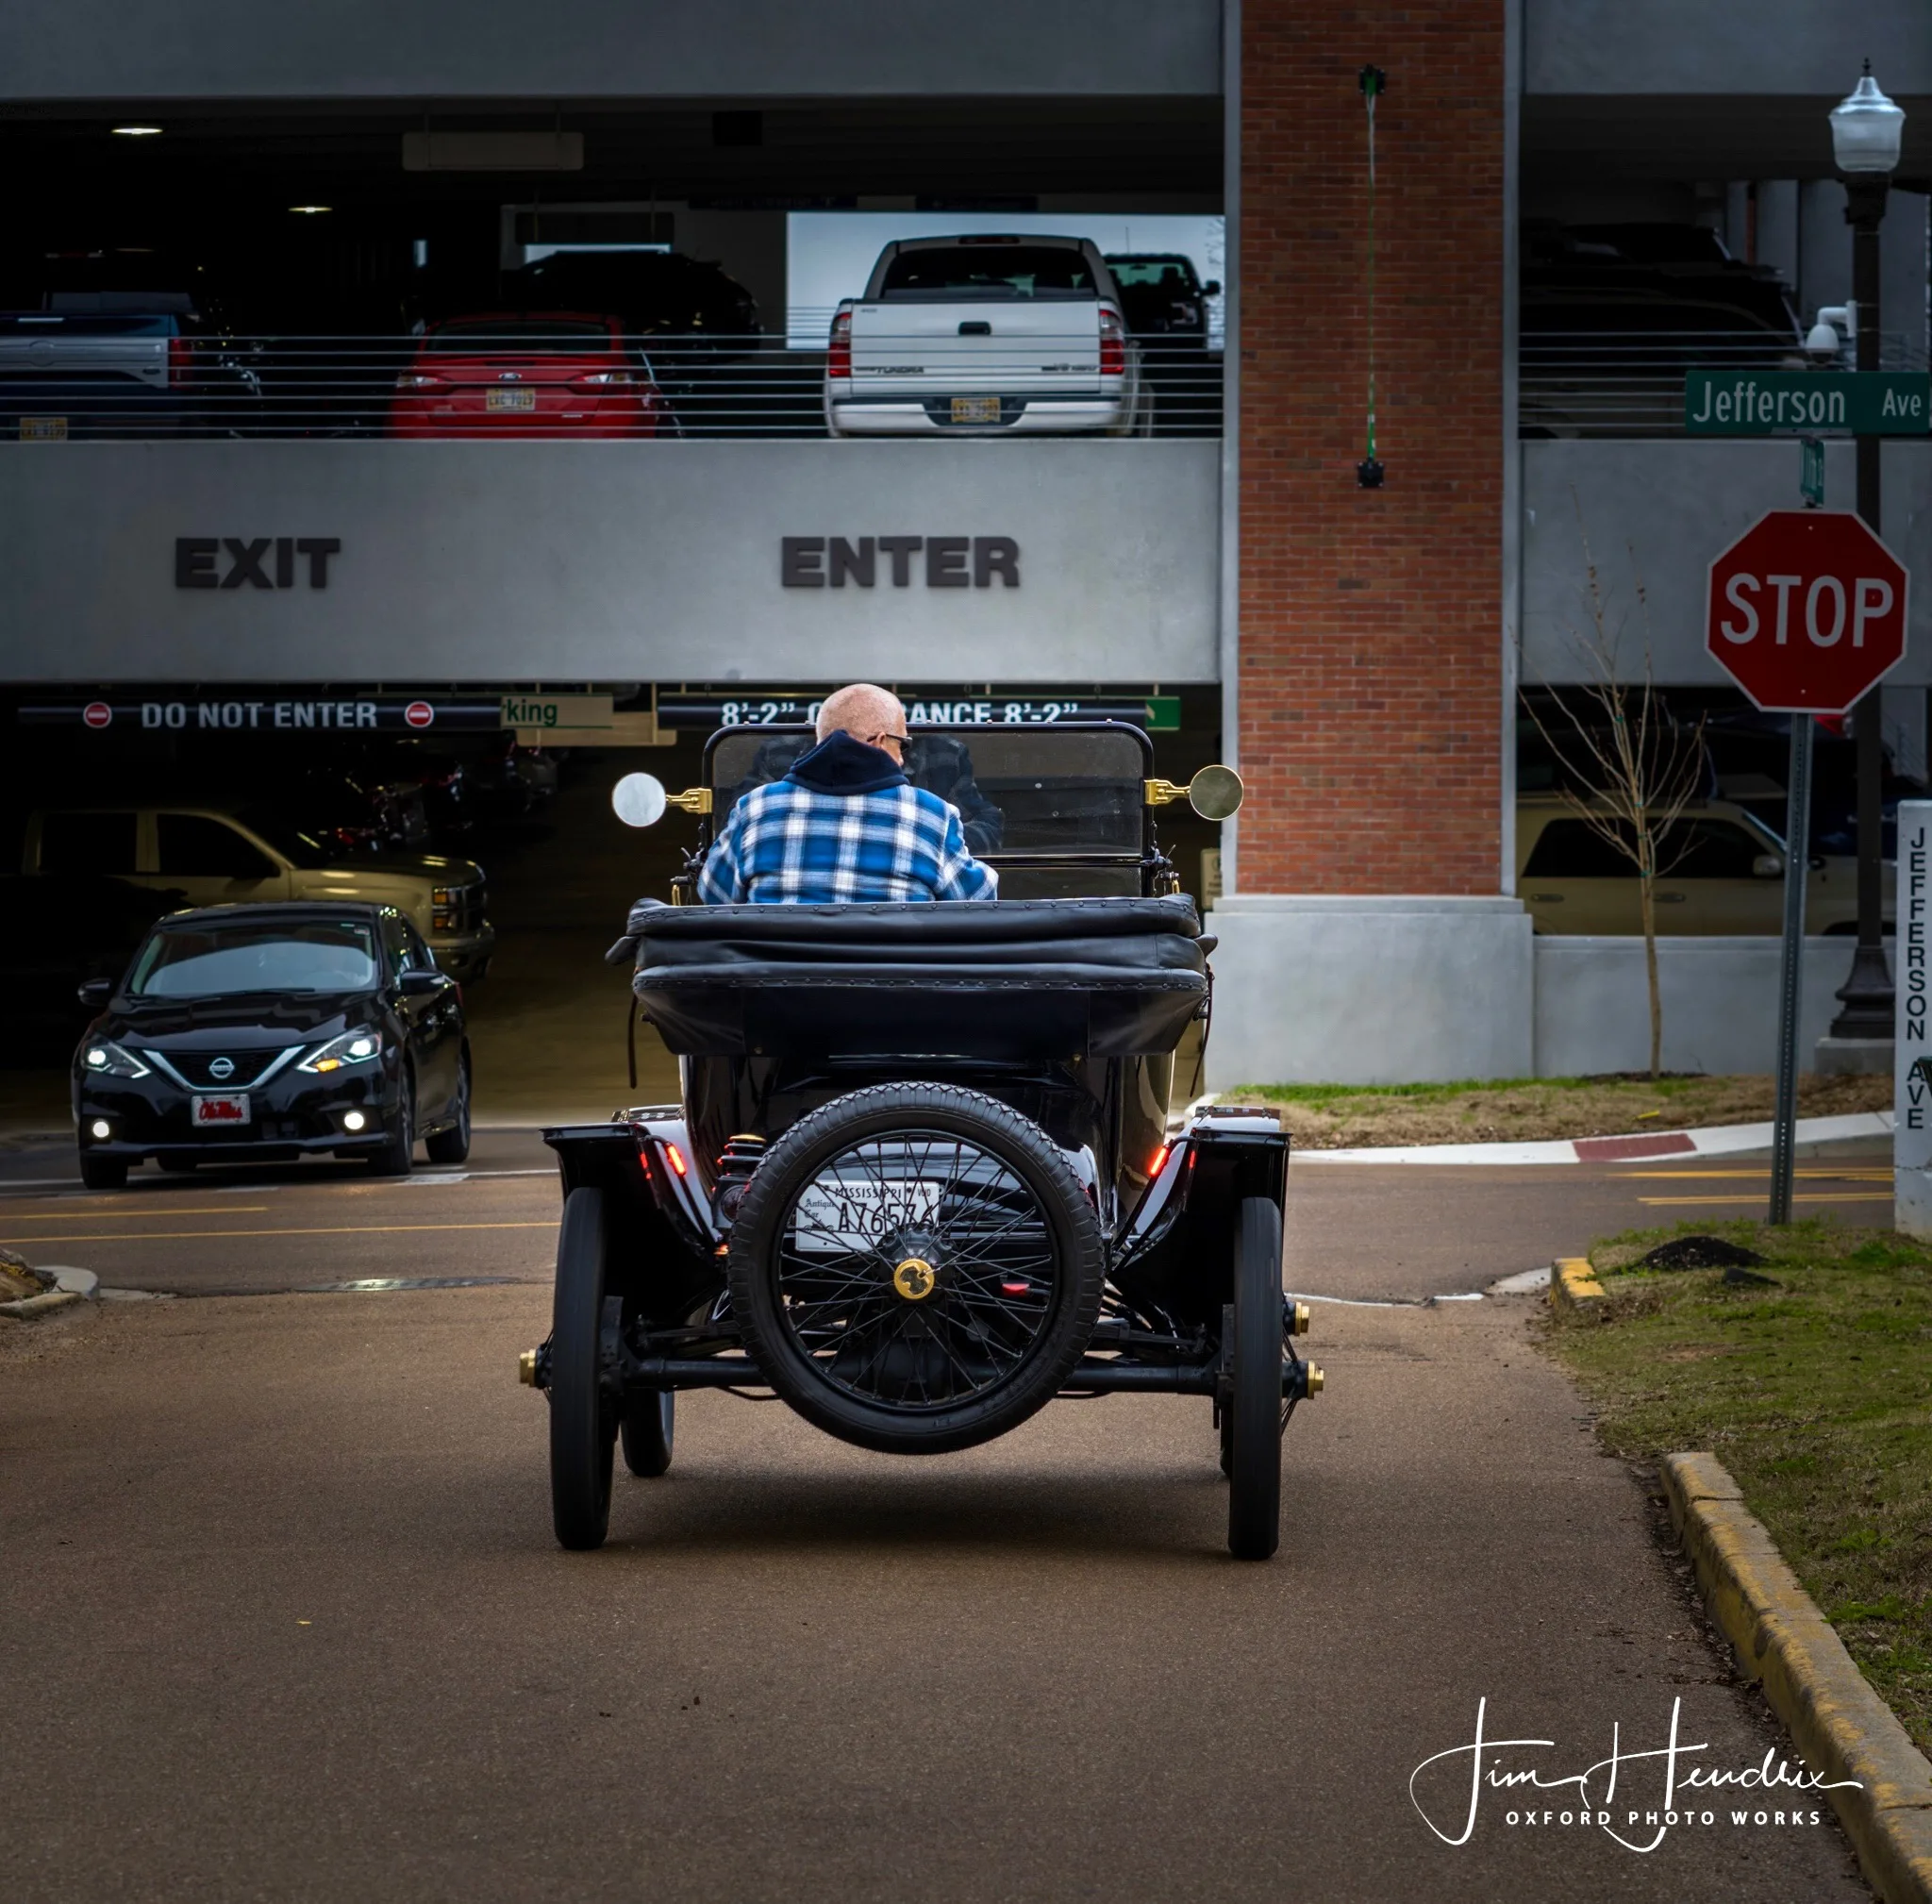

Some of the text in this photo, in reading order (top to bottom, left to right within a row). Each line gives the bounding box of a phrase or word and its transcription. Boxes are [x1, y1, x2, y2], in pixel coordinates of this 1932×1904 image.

[1693, 381, 1922, 423] Jefferson Ave
[175, 537, 341, 590] EXIT
[781, 536, 1021, 589] ENTER
[1721, 572, 1894, 648] STOP
[142, 702, 377, 727] DO NOT ENTER
[501, 699, 558, 727] king
[808, 702, 991, 724] CANCE
[1907, 827, 1927, 1129] JEFFERSON AVE
[835, 1187, 902, 1198] MISSISSIPPI
